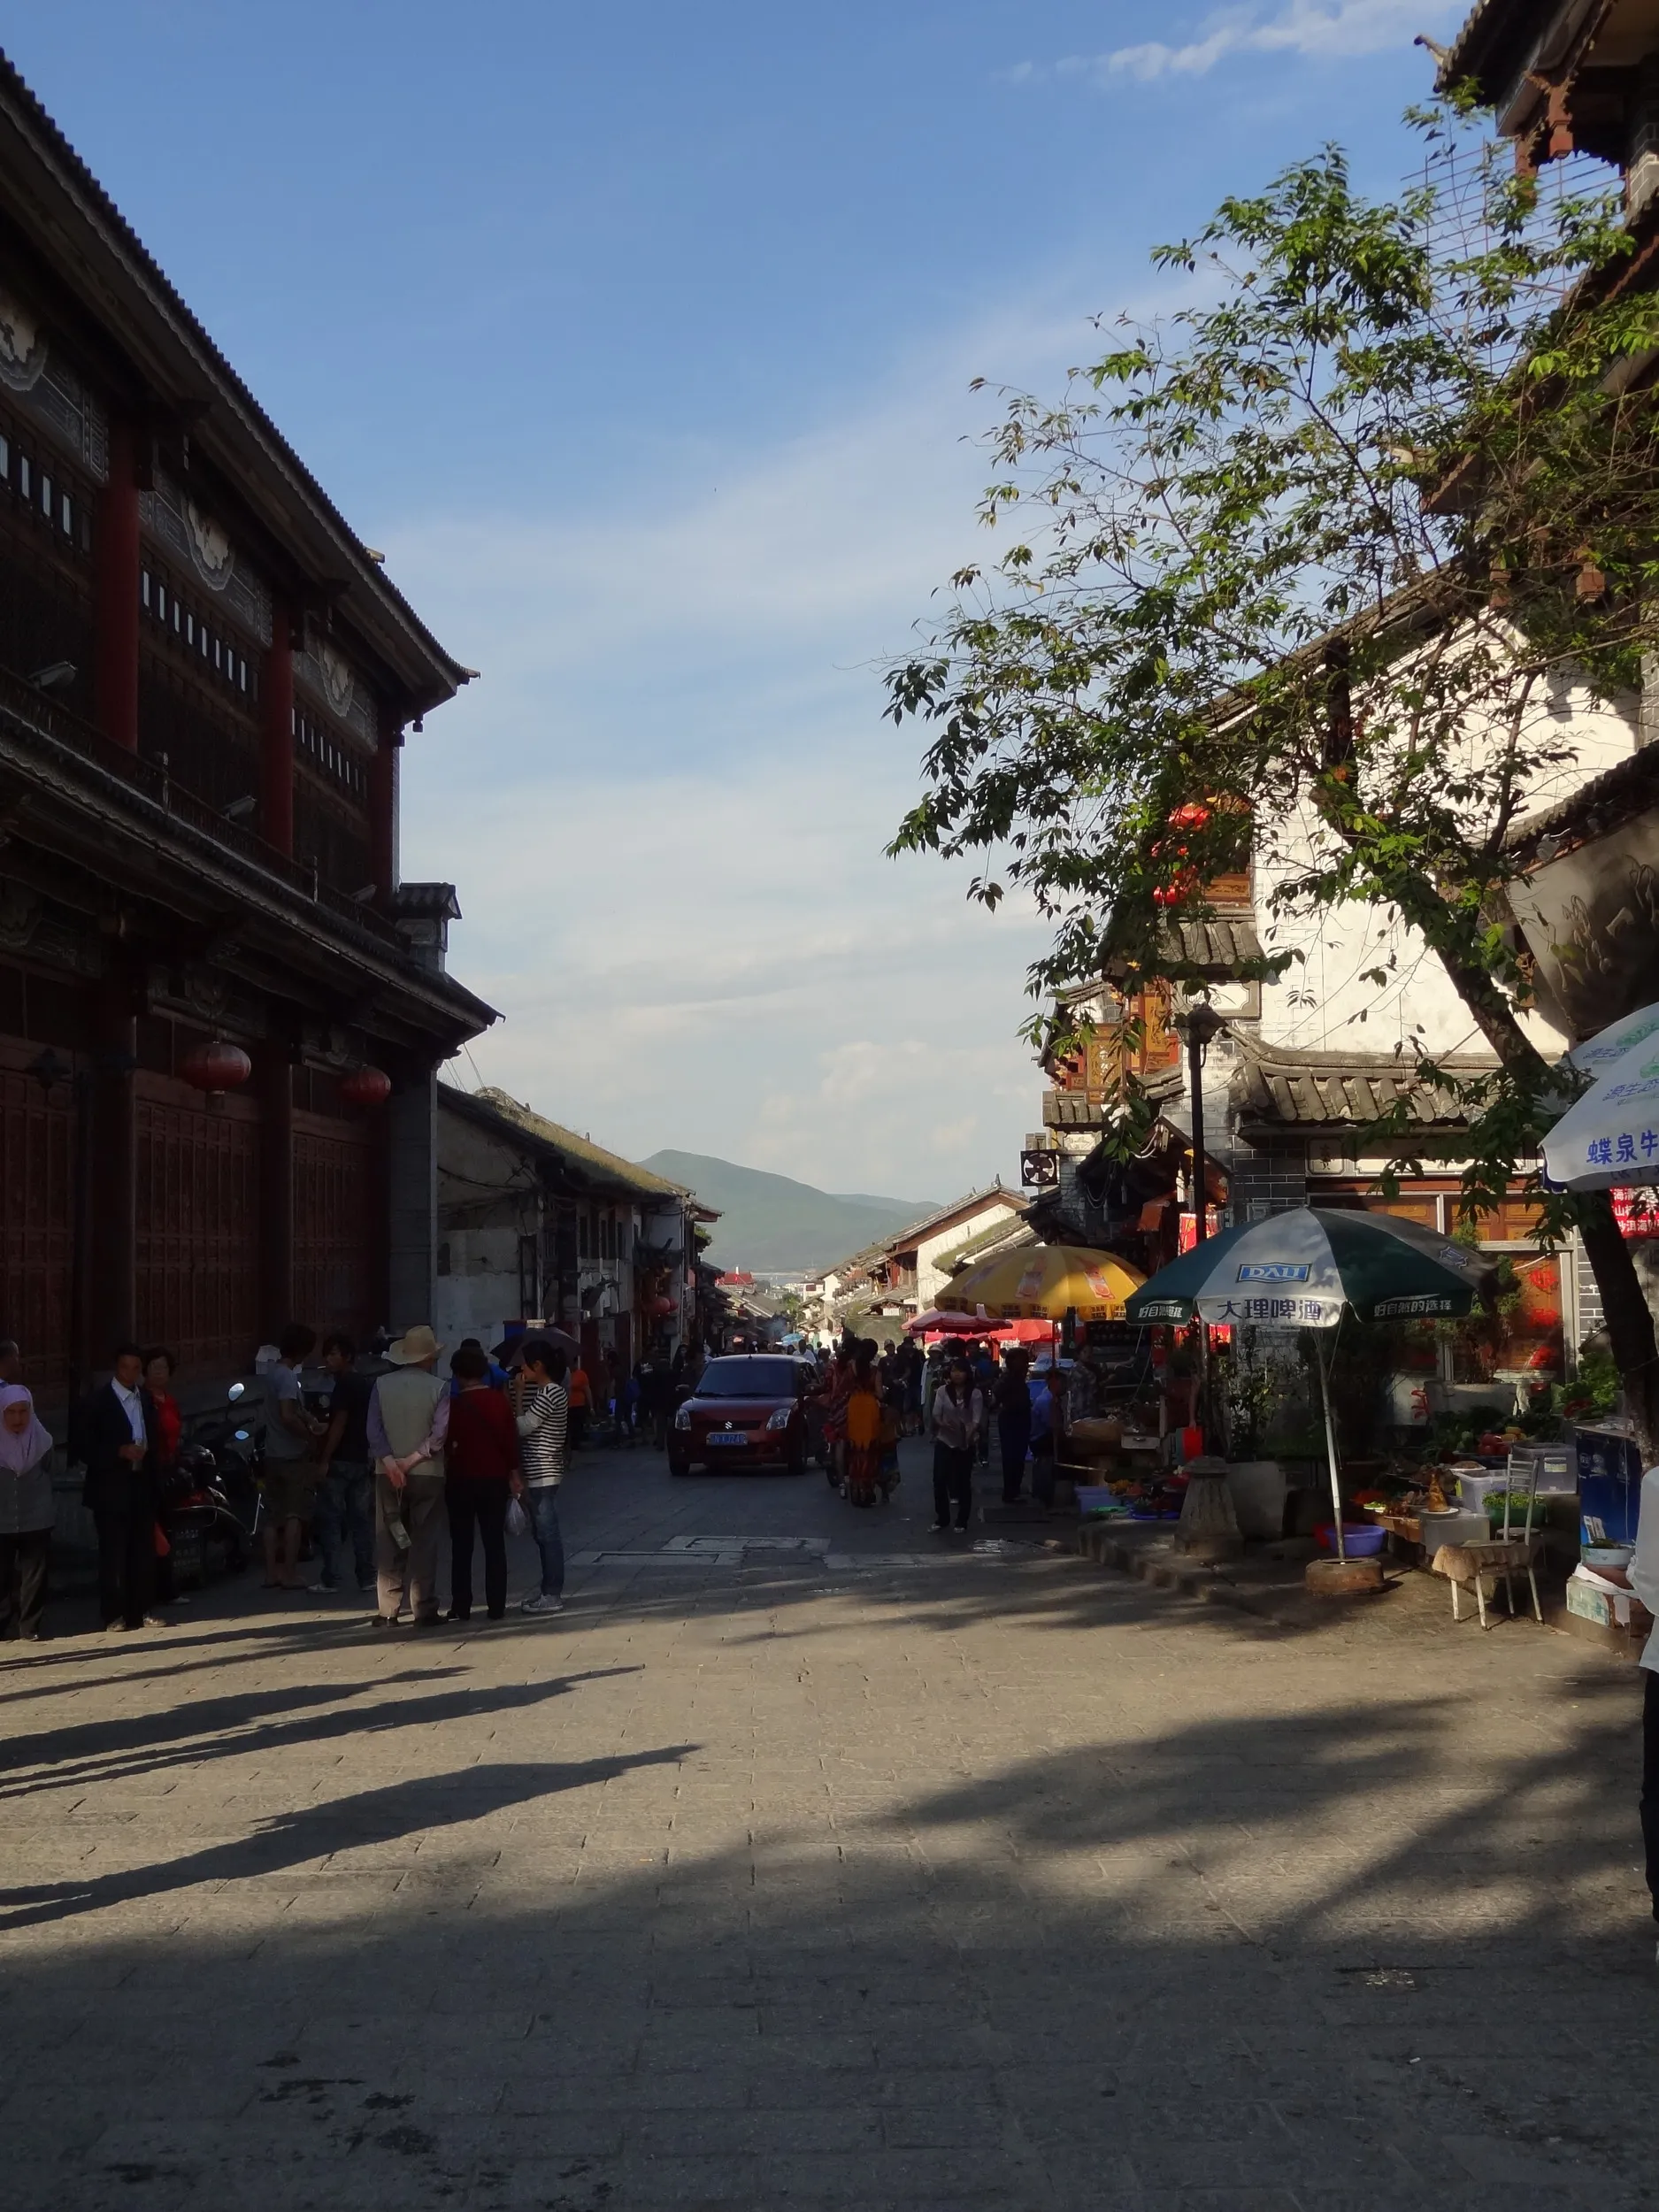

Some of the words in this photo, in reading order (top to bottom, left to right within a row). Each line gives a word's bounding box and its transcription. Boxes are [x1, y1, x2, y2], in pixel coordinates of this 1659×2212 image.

[1586, 1130, 1658, 1164] 蝶泉牛
[1217, 1298, 1322, 1321] 大理啤酒
[1373, 1300, 1452, 1317] 好自然的选择
